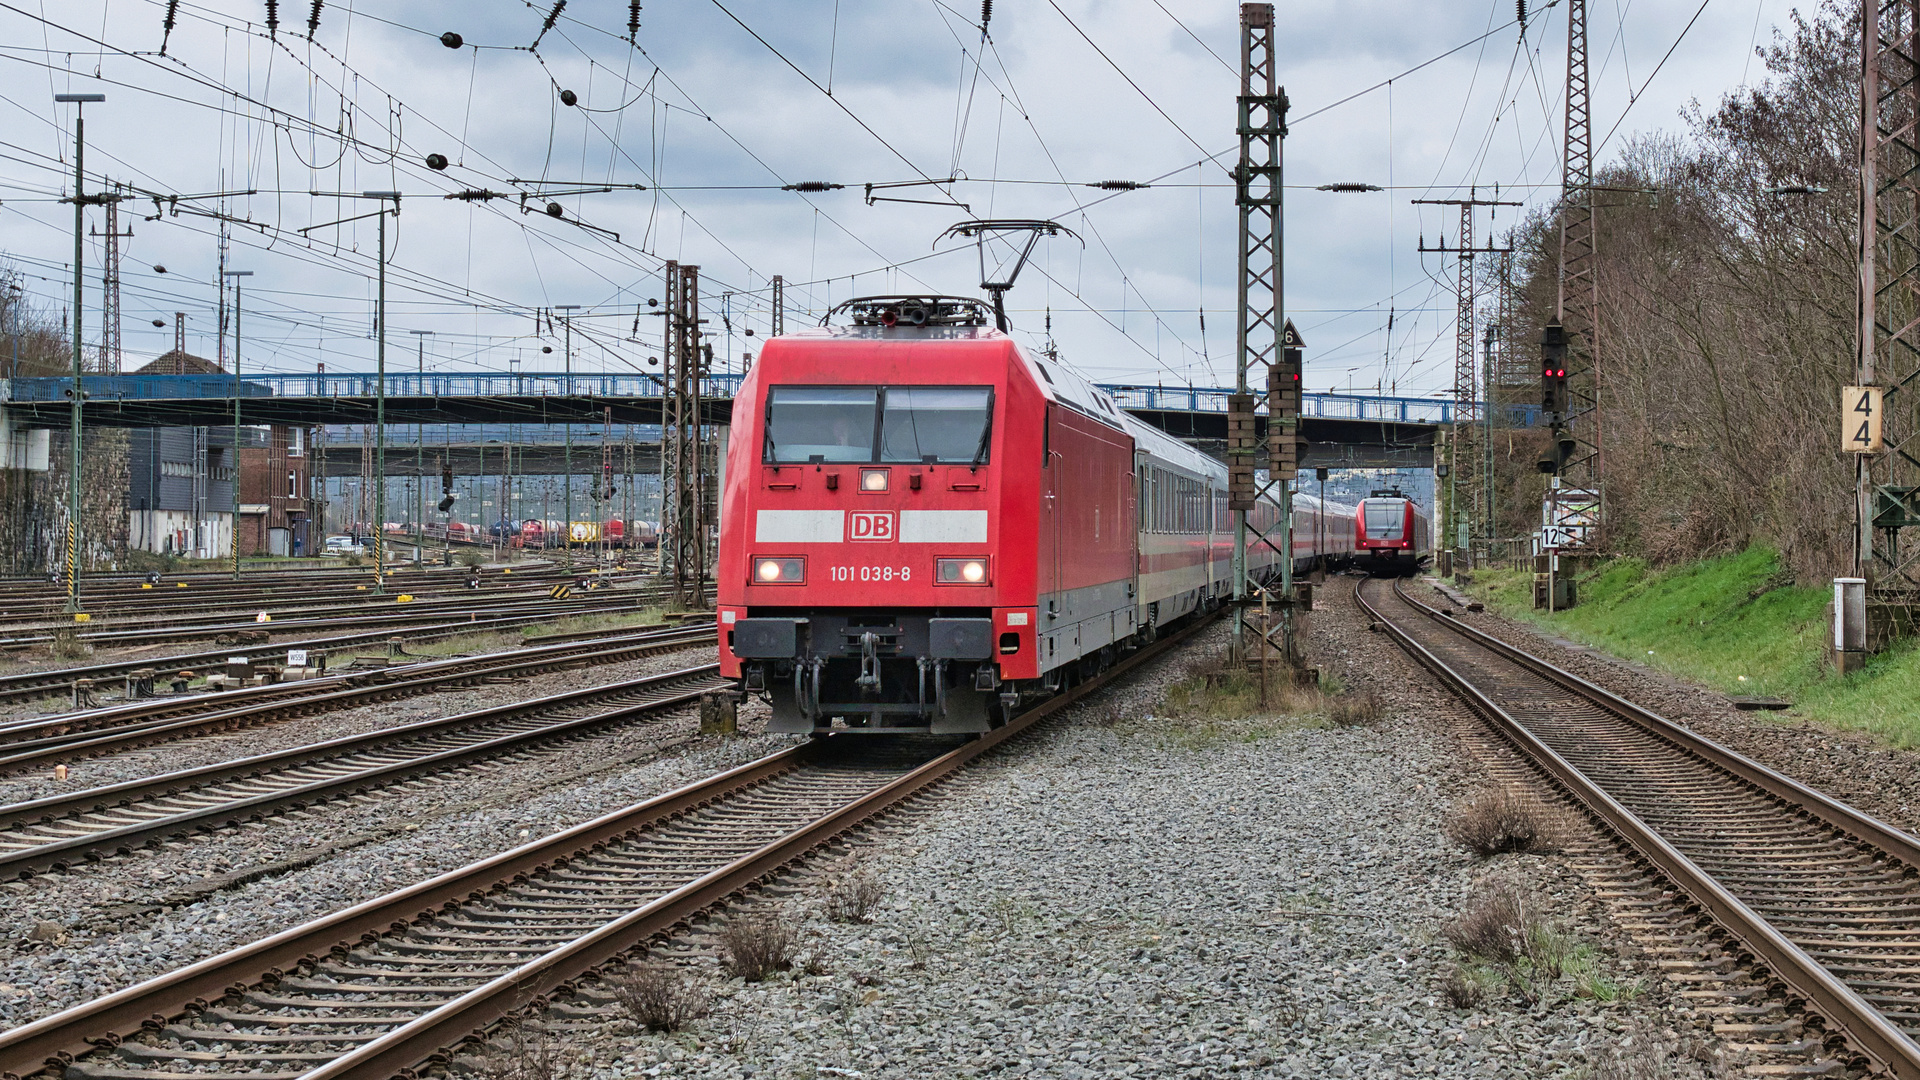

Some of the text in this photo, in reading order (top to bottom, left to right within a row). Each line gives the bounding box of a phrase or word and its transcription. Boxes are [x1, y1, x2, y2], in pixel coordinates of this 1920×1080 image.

[1285, 330, 1293, 344] 6
[1854, 390, 1872, 417] 4
[1853, 420, 1871, 446] 4
[854, 515, 890, 537] DB
[1543, 528, 1559, 545] 12
[830, 566, 911, 581] 101 038-8
